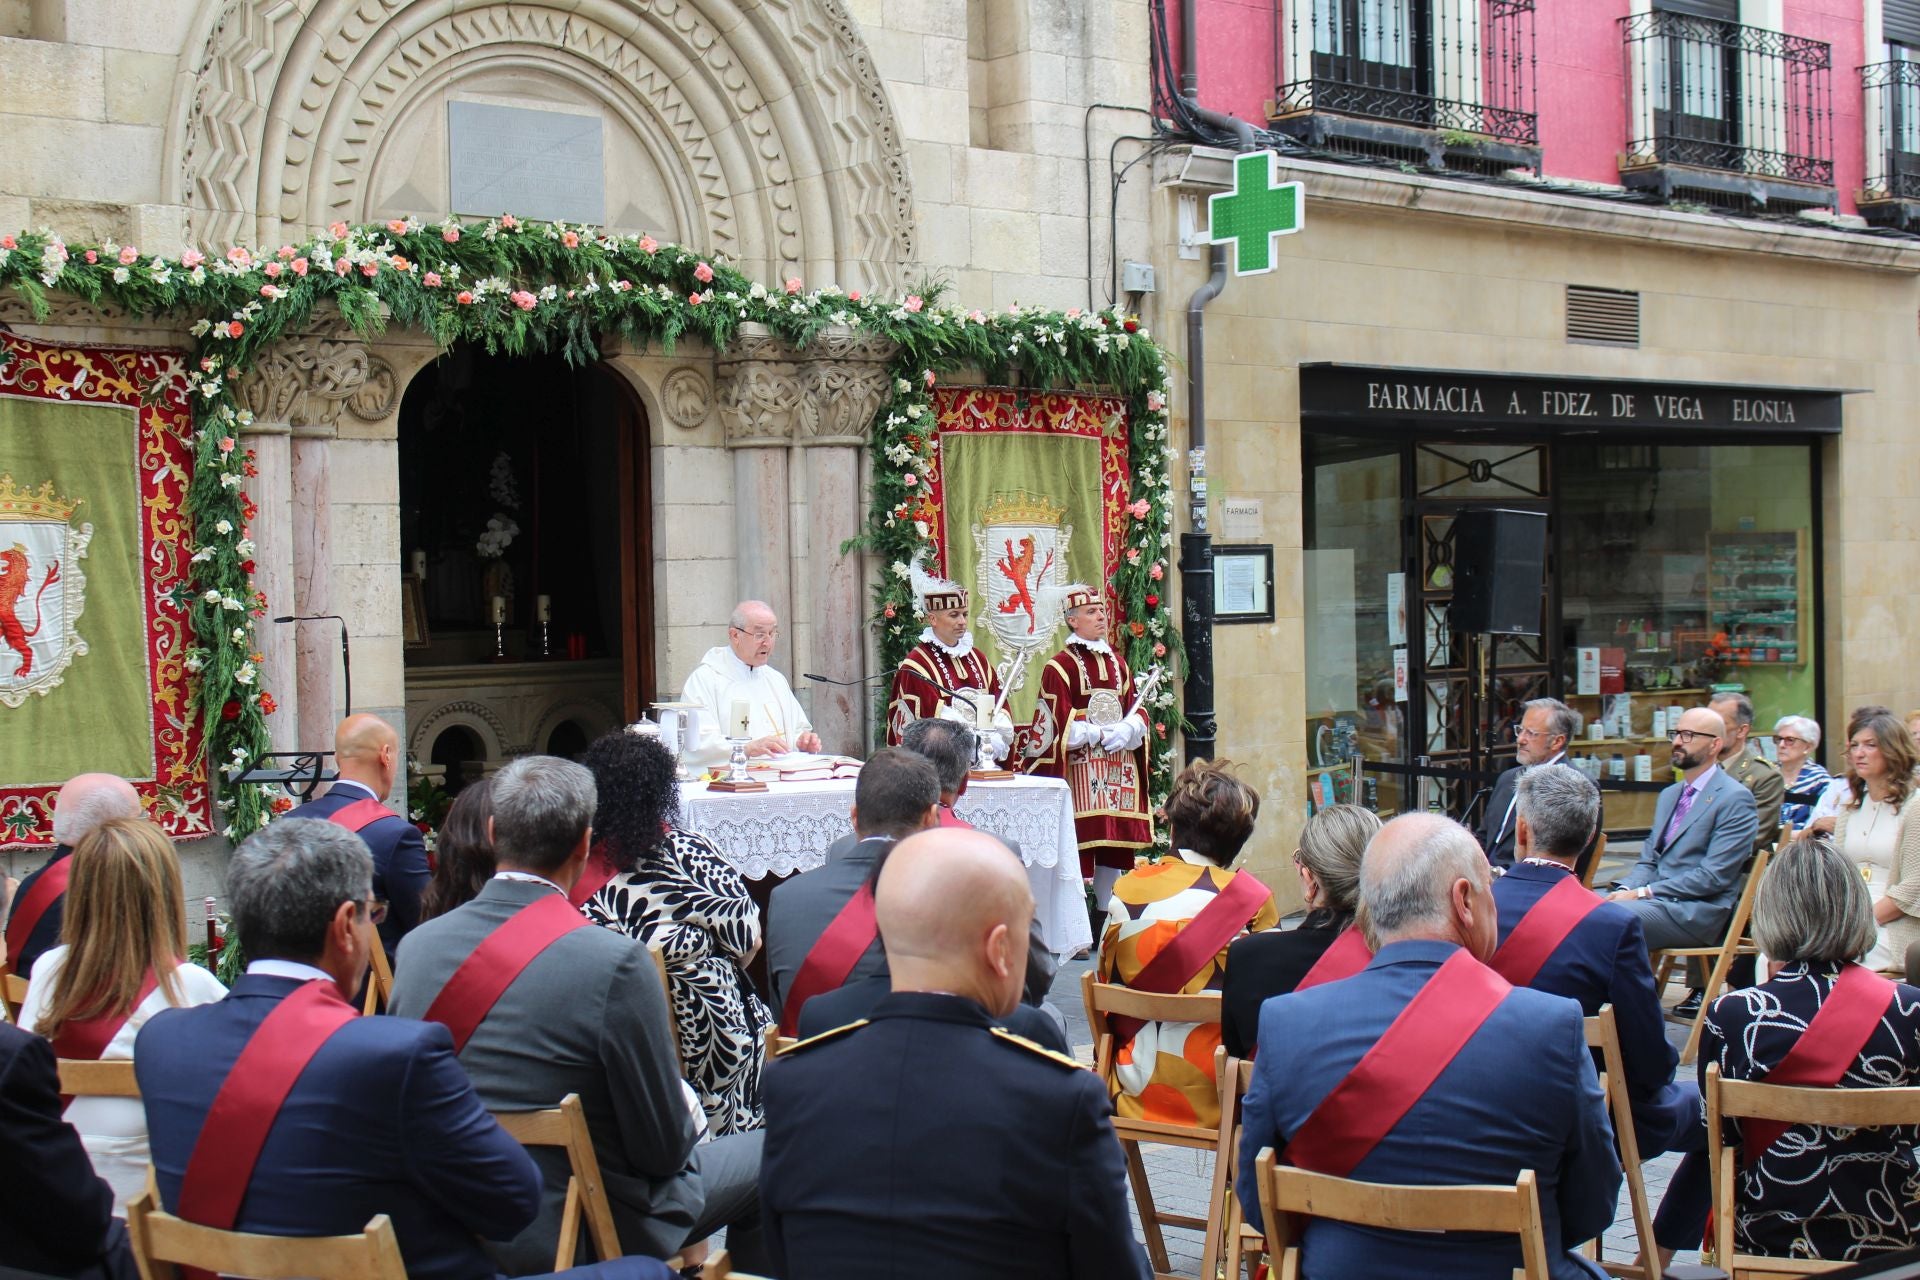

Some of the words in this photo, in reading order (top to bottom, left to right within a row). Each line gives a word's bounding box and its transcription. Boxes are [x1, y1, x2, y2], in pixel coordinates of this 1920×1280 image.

[1367, 382, 1485, 414] FARMACIA
[1507, 391, 1528, 416] A.
[1541, 391, 1599, 417] FDEZ.
[1611, 393, 1637, 419] DE
[1653, 395, 1705, 421] VEGA
[1732, 399, 1797, 424] ELOSUA
[1226, 507, 1259, 516] FARMACIA
